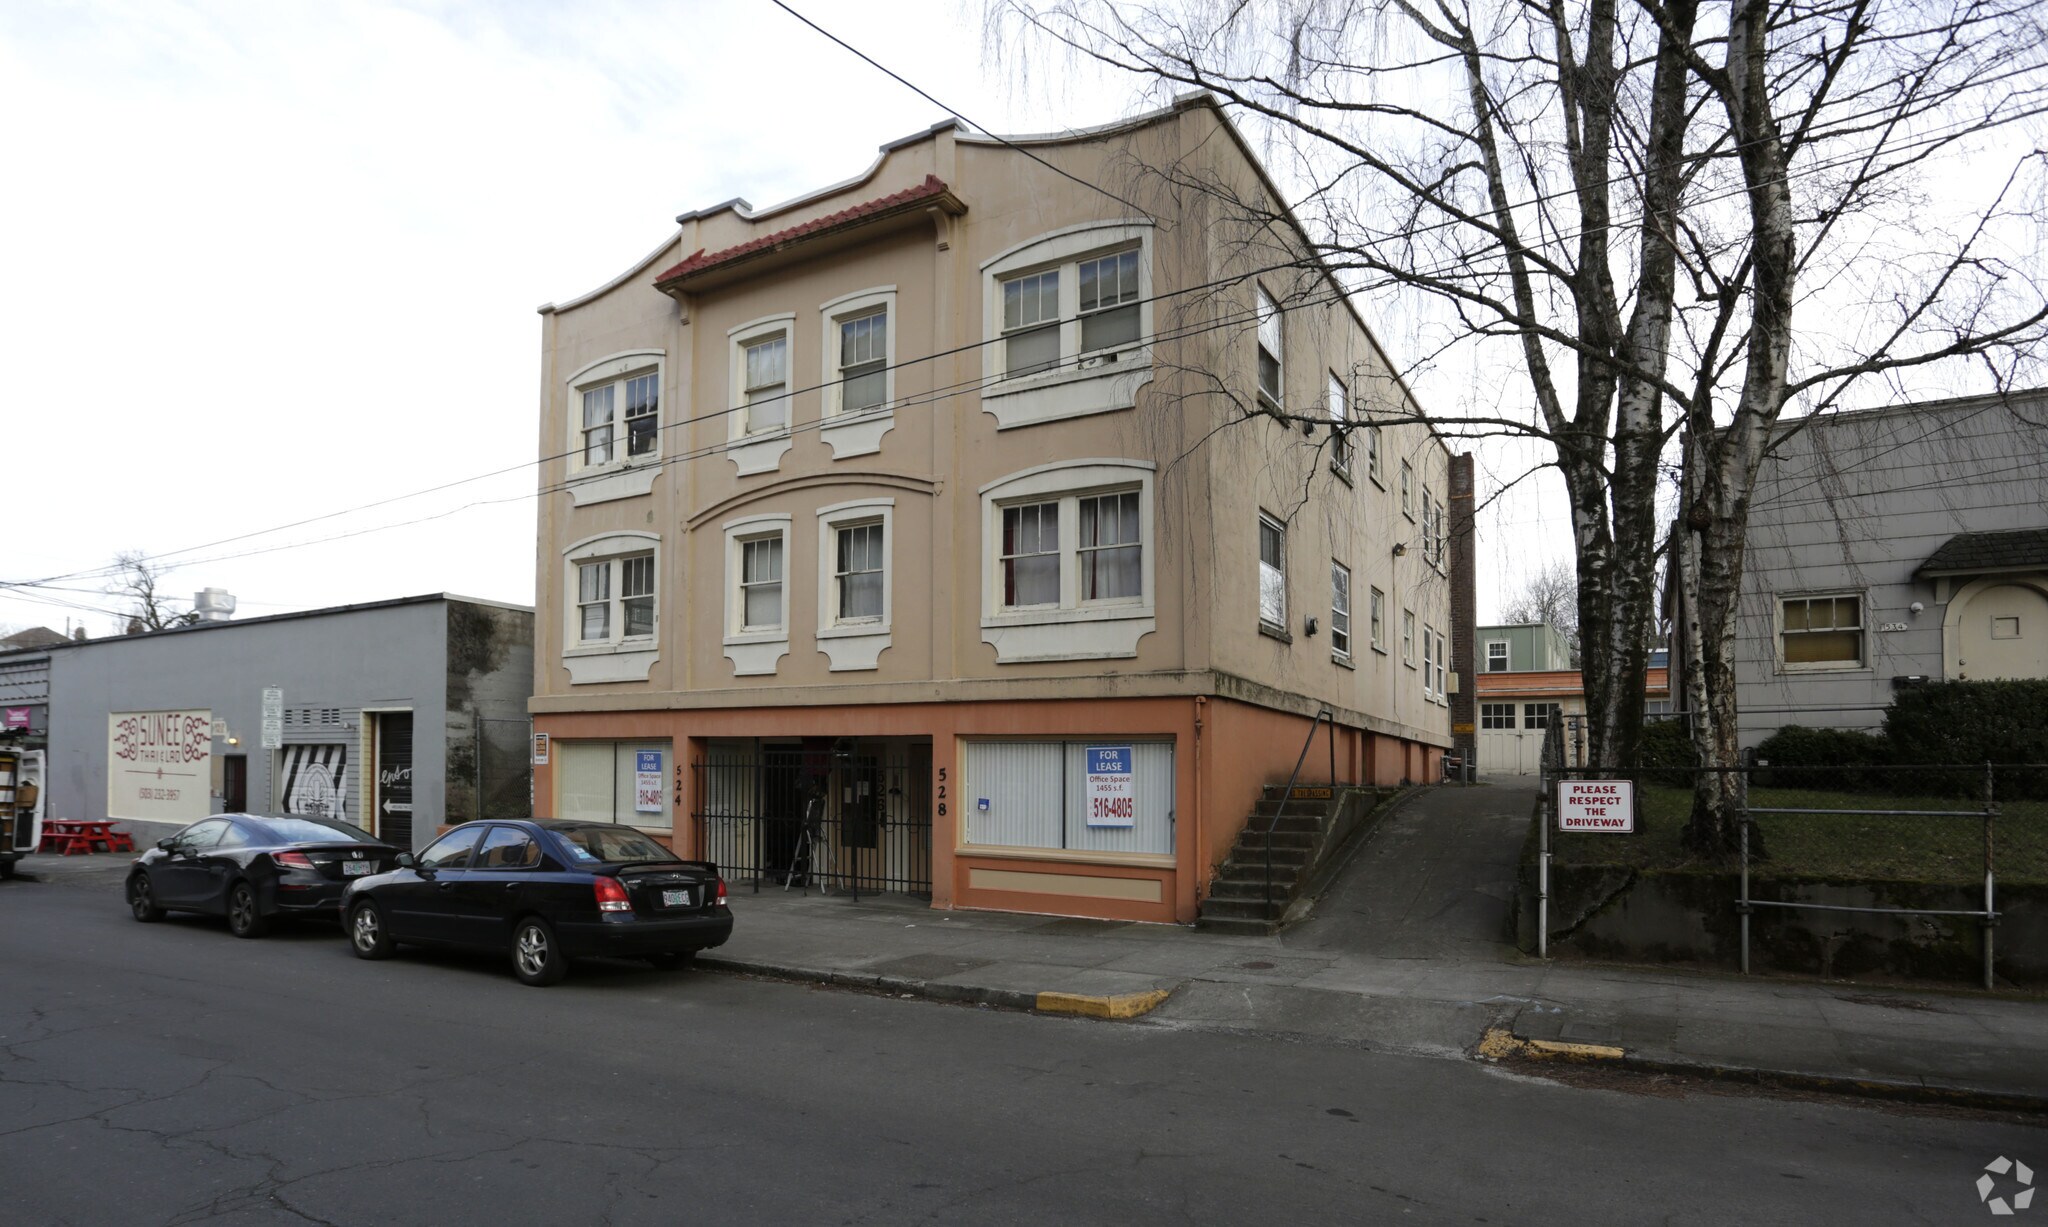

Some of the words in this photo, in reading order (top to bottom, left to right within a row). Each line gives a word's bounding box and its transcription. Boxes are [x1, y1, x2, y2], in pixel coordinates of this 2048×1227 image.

[140, 714, 181, 746] SUNEE
[140, 750, 159, 762] THAI
[165, 750, 181, 763] LAO
[1099, 750, 1119, 760] FOR
[1095, 762, 1123, 771] LEASE
[1089, 775, 1109, 783] Office
[1110, 775, 1131, 783] Space
[674, 765, 682, 806] 524
[1113, 784, 1124, 792] s.f.
[1573, 786, 1617, 794] PLEASE
[938, 767, 947, 816] 528
[1569, 797, 1622, 805] RESPECT
[1093, 797, 1133, 818] 516-4805
[1584, 808, 1607, 816] THE
[1566, 818, 1625, 827] DRIVEWAY
